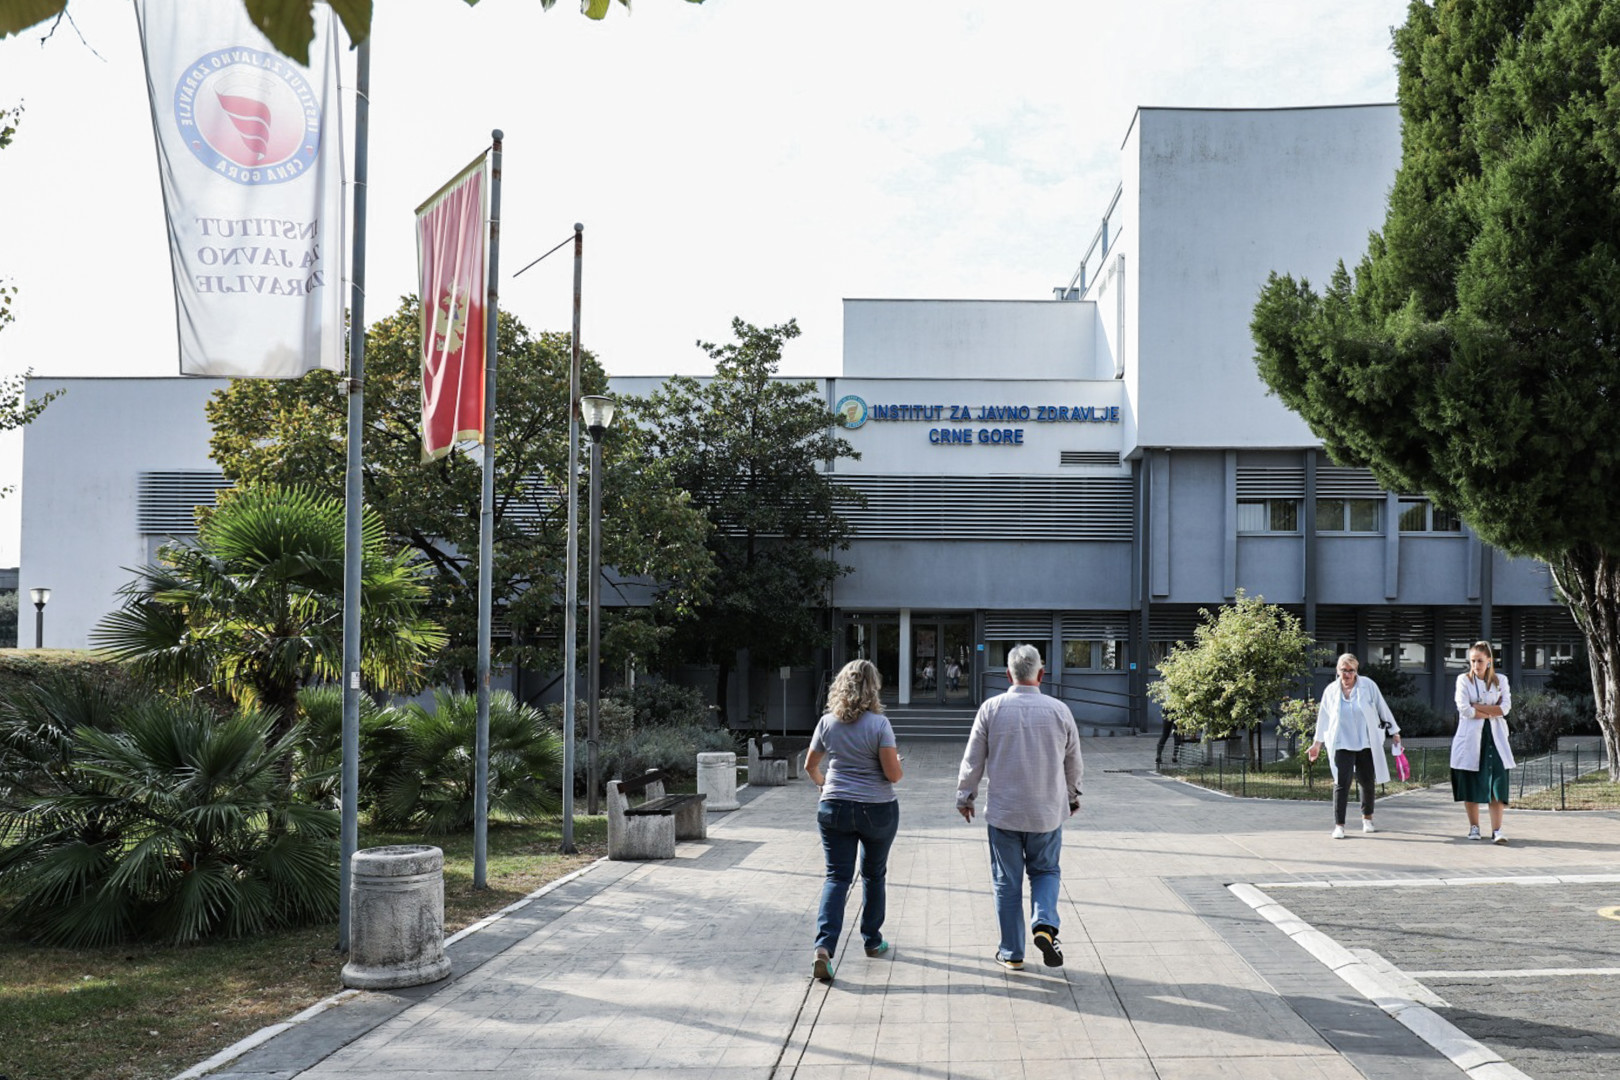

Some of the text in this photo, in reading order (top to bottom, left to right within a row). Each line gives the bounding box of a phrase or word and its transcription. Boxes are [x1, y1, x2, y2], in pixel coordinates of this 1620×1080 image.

[873, 405, 944, 421] INSTITUT
[950, 405, 972, 421] ZA
[977, 405, 1030, 421] JAVNO
[1036, 405, 1120, 422] ZDRAVLJE
[928, 428, 1024, 444] CRNE GORE
